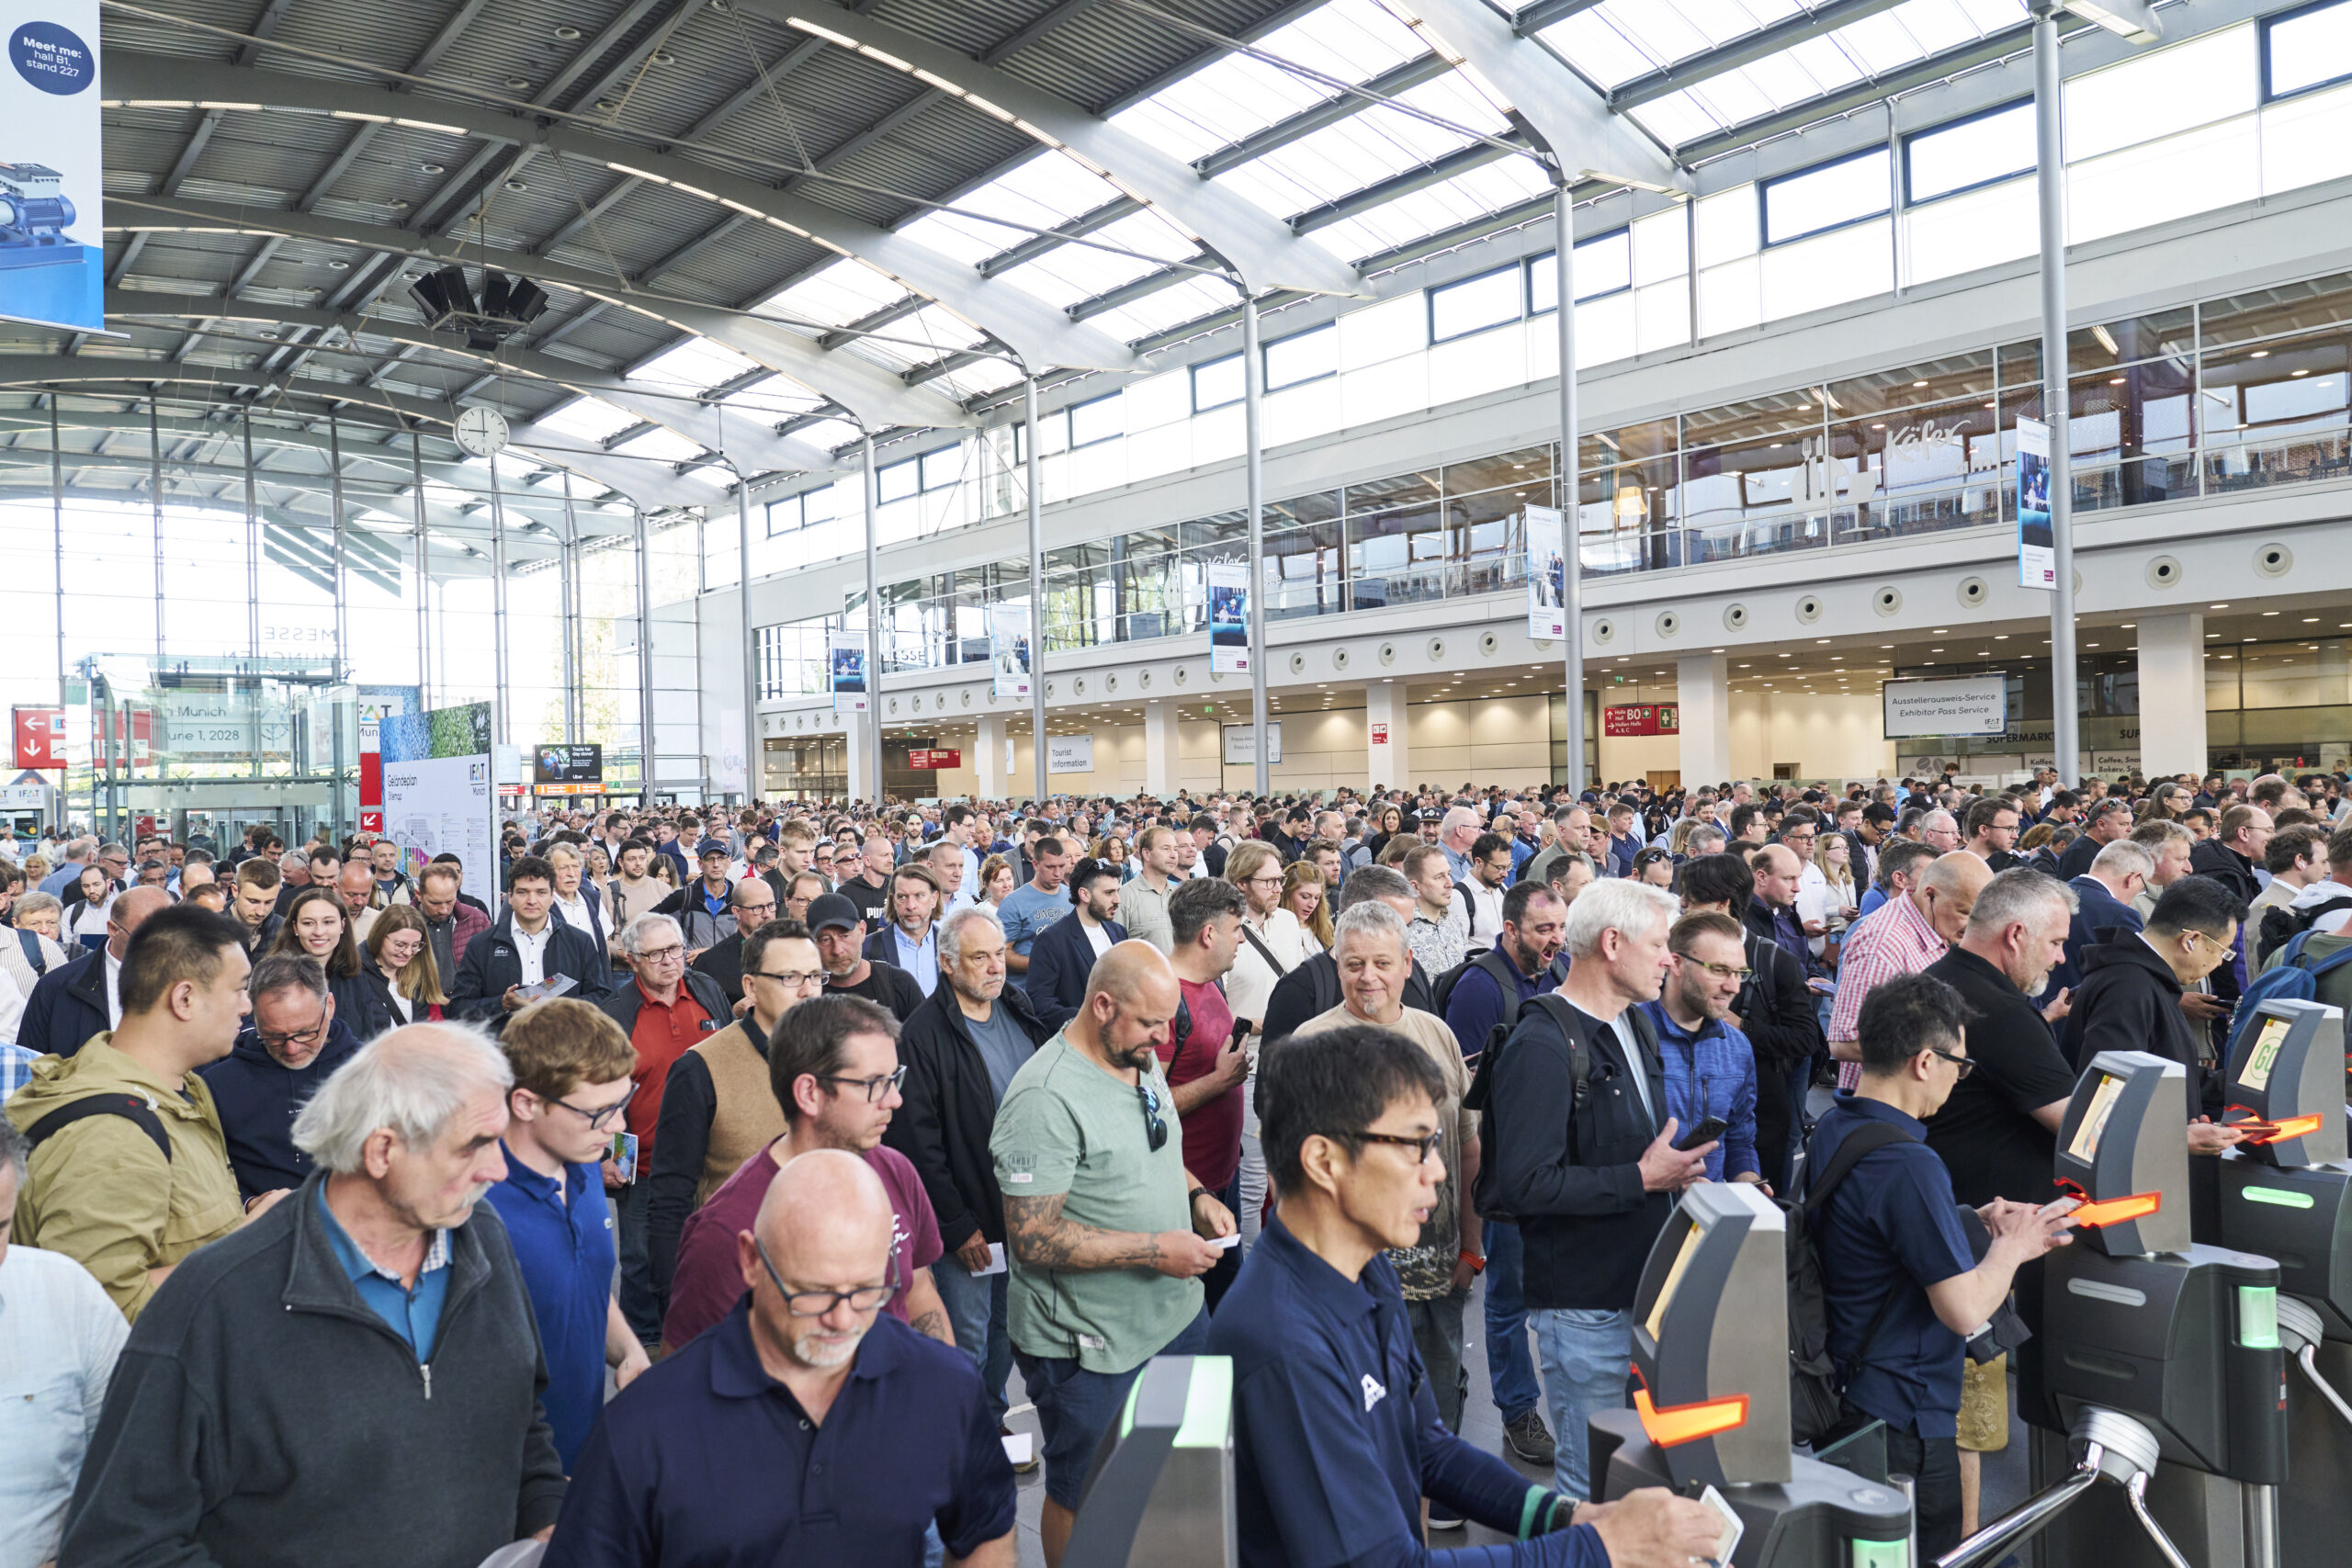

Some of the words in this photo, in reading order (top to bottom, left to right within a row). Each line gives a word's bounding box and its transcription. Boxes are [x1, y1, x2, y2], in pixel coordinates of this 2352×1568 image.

[23, 37, 57, 53] Meet
[59, 47, 82, 59] me:
[34, 50, 53, 62] hall
[26, 60, 57, 73] stand
[59, 66, 80, 77] 227
[1885, 420, 1972, 463] Käfer
[1892, 694, 1996, 705] Ausstellerausweis-Service
[177, 705, 227, 717] Munich
[1900, 708, 1936, 717] Exhibitor
[1938, 707, 1956, 716] Pass
[1959, 706, 1989, 715] Service
[167, 732, 194, 741] une
[209, 729, 240, 741] 2028
[2120, 728, 2140, 739] SUP
[1051, 749, 1072, 757] Tourist
[1052, 760, 1087, 768] Information
[469, 762, 485, 782] IFAT
[18, 789, 40, 798] IFAT
